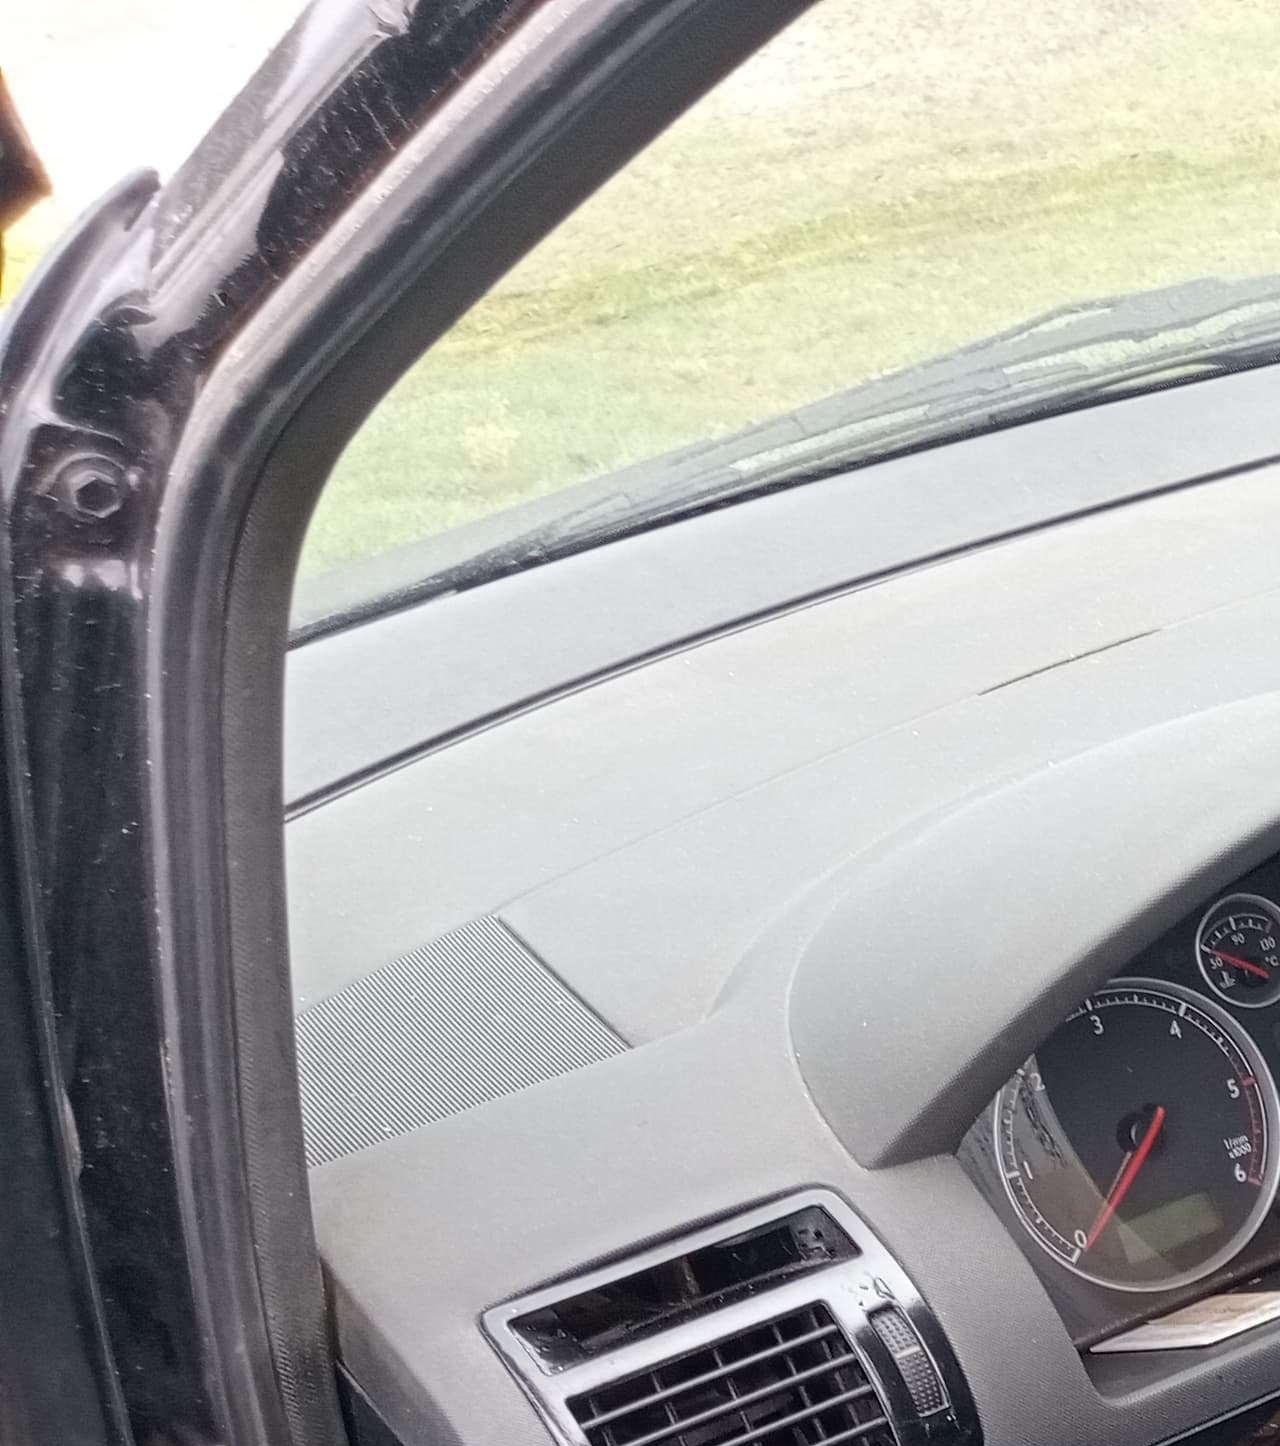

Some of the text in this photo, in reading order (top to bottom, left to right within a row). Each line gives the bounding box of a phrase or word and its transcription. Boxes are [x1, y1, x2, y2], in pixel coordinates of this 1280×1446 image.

[1260, 936, 1276, 951] 130
[1089, 1016, 1104, 1035] 3
[1169, 1020, 1182, 1039] 4
[1030, 1073, 1046, 1092] 2
[1226, 1078, 1240, 1098] 5
[1234, 1162, 1247, 1182] 6
[1074, 1229, 1087, 1248] 0
